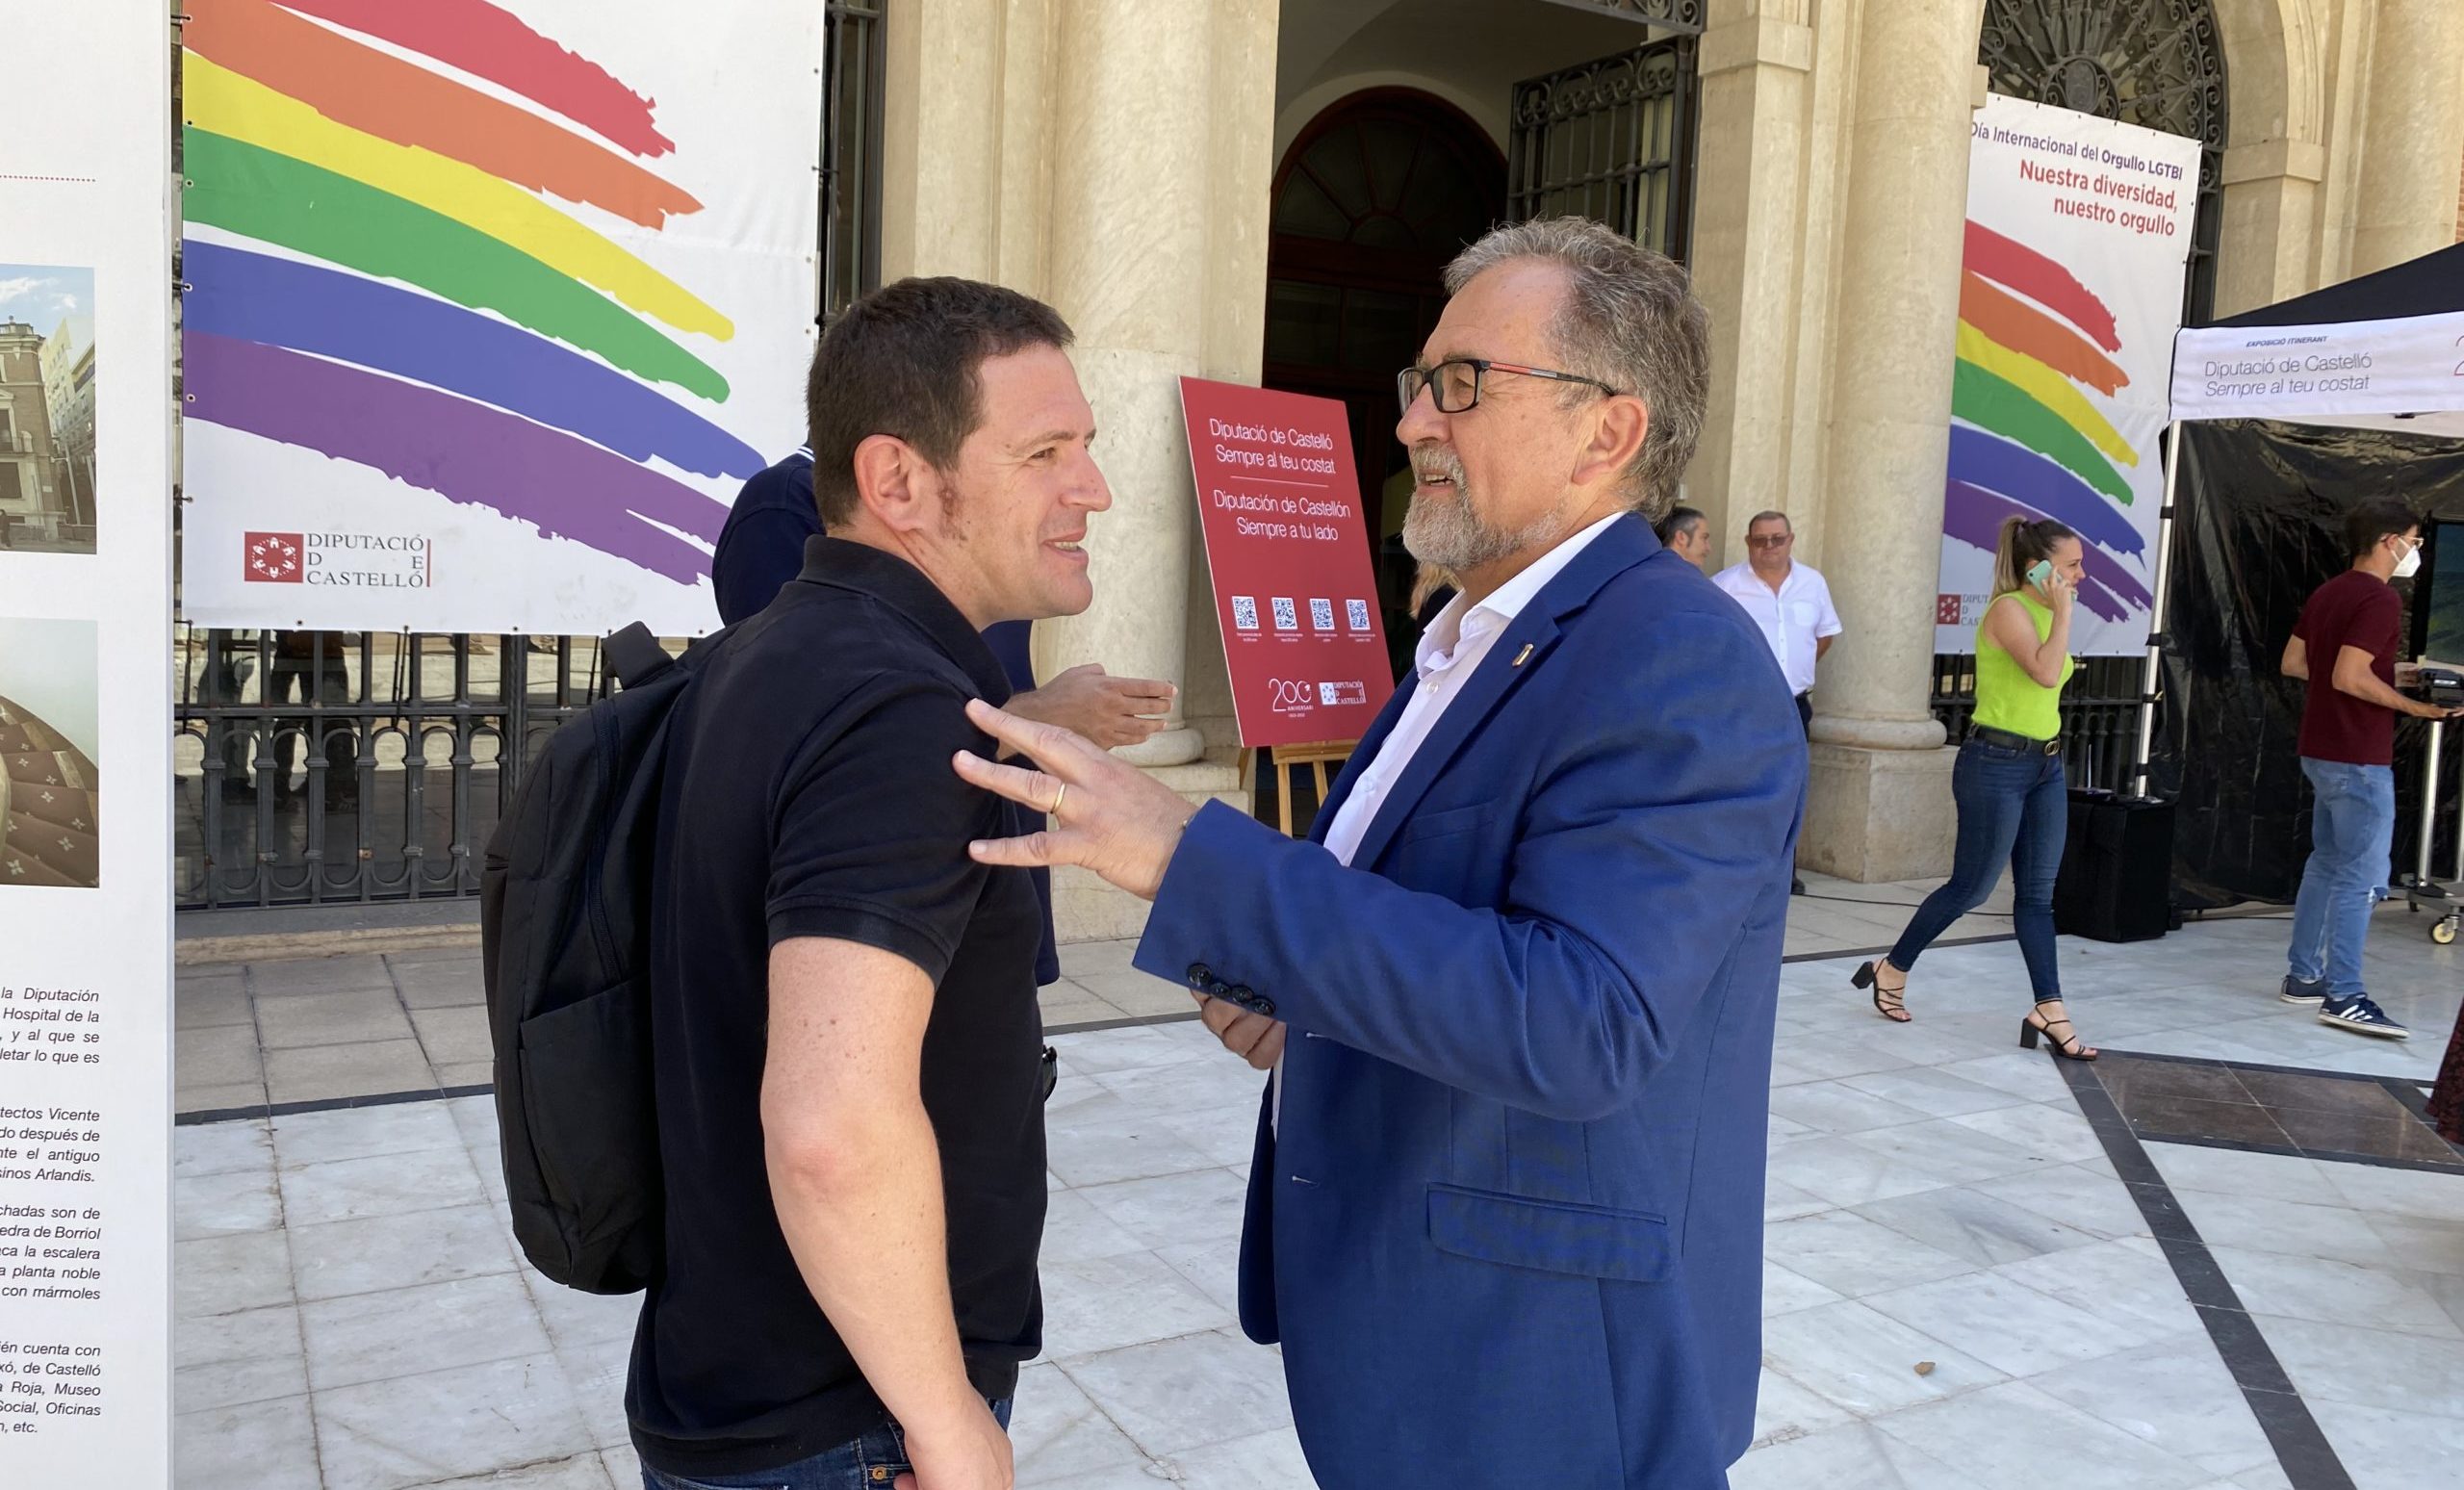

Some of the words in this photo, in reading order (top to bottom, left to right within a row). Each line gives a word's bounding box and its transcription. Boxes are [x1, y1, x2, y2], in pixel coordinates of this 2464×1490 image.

[1971, 121, 1989, 141] Día
[1993, 126, 2077, 157] Internacional
[2081, 143, 2098, 162] del
[2101, 150, 2145, 172] Orgullo
[2148, 160, 2184, 181] LGTBI
[2020, 159, 2089, 191] Nuestra
[2093, 173, 2178, 213] diversidad,
[2054, 197, 2116, 224] nuestro
[2119, 211, 2175, 237] orgullo
[2246, 337, 2287, 347] EXPOSICIÓ
[2287, 335, 2329, 346] ITINERANT
[2205, 358, 2275, 379] Diputació
[2279, 358, 2300, 373] de
[2305, 352, 2373, 372] Castelló
[2205, 380, 2266, 399] Sempre
[2271, 378, 2284, 394] al
[2289, 379, 2315, 394] teu
[2319, 375, 2371, 392] costat
[1209, 418, 1268, 443] Diputació
[1270, 427, 1286, 445] de
[1288, 428, 1333, 450] Castelló
[1215, 444, 1265, 468] Sempre
[1267, 450, 1278, 468] al
[1279, 452, 1299, 470] teu
[1300, 457, 1336, 475] costat
[1214, 489, 1279, 512] Diputación
[1281, 497, 1297, 514] de
[1299, 497, 1351, 519] Castellón
[1236, 516, 1287, 539] Siempre
[1290, 527, 1299, 539] a
[1299, 523, 1313, 540] tu
[1314, 523, 1339, 541] lado
[307, 533, 424, 552] DIPUTACIÓ
[307, 552, 322, 566] D
[412, 555, 424, 570] E
[306, 570, 424, 589] CASTELLÓ
[1, 986, 13, 999] la
[23, 987, 100, 1003] Diputación
[3, 1007, 61, 1023] Hospital
[64, 1010, 84, 1022] de
[87, 1011, 100, 1023] la
[11, 1030, 21, 1043] y
[27, 1029, 41, 1040] al
[48, 1031, 75, 1043] que
[83, 1032, 100, 1043] se
[34, 1049, 47, 1062] lo
[52, 1051, 79, 1065] que
[84, 1052, 100, 1064] es
[48, 1108, 100, 1121] Vicente
[19, 1127, 79, 1143] después
[82, 1130, 100, 1143] de
[26, 1147, 39, 1160] el
[47, 1149, 100, 1164] antiguo
[0, 1167, 32, 1180] inos
[34, 1168, 95, 1183] Arlandis.
[50, 1208, 77, 1220] son
[82, 1206, 101, 1220] de
[33, 1225, 51, 1239] de
[55, 1226, 101, 1241] Borriol
[0, 1246, 18, 1257] ca
[24, 1245, 37, 1258] la
[42, 1246, 101, 1260] escalera
[12, 1265, 56, 1279] planta
[62, 1266, 101, 1280] noble
[1, 1287, 28, 1297] con
[32, 1285, 101, 1300] mármoles
[0, 1341, 17, 1353] én
[22, 1342, 70, 1356] cuenta
[74, 1346, 101, 1357] con
[23, 1362, 40, 1374] de
[45, 1361, 101, 1377] Castelló
[11, 1380, 45, 1397] Roja,
[54, 1382, 101, 1397] Museo
[45, 1401, 101, 1417] Oficinas
[13, 1421, 38, 1434] etc.
